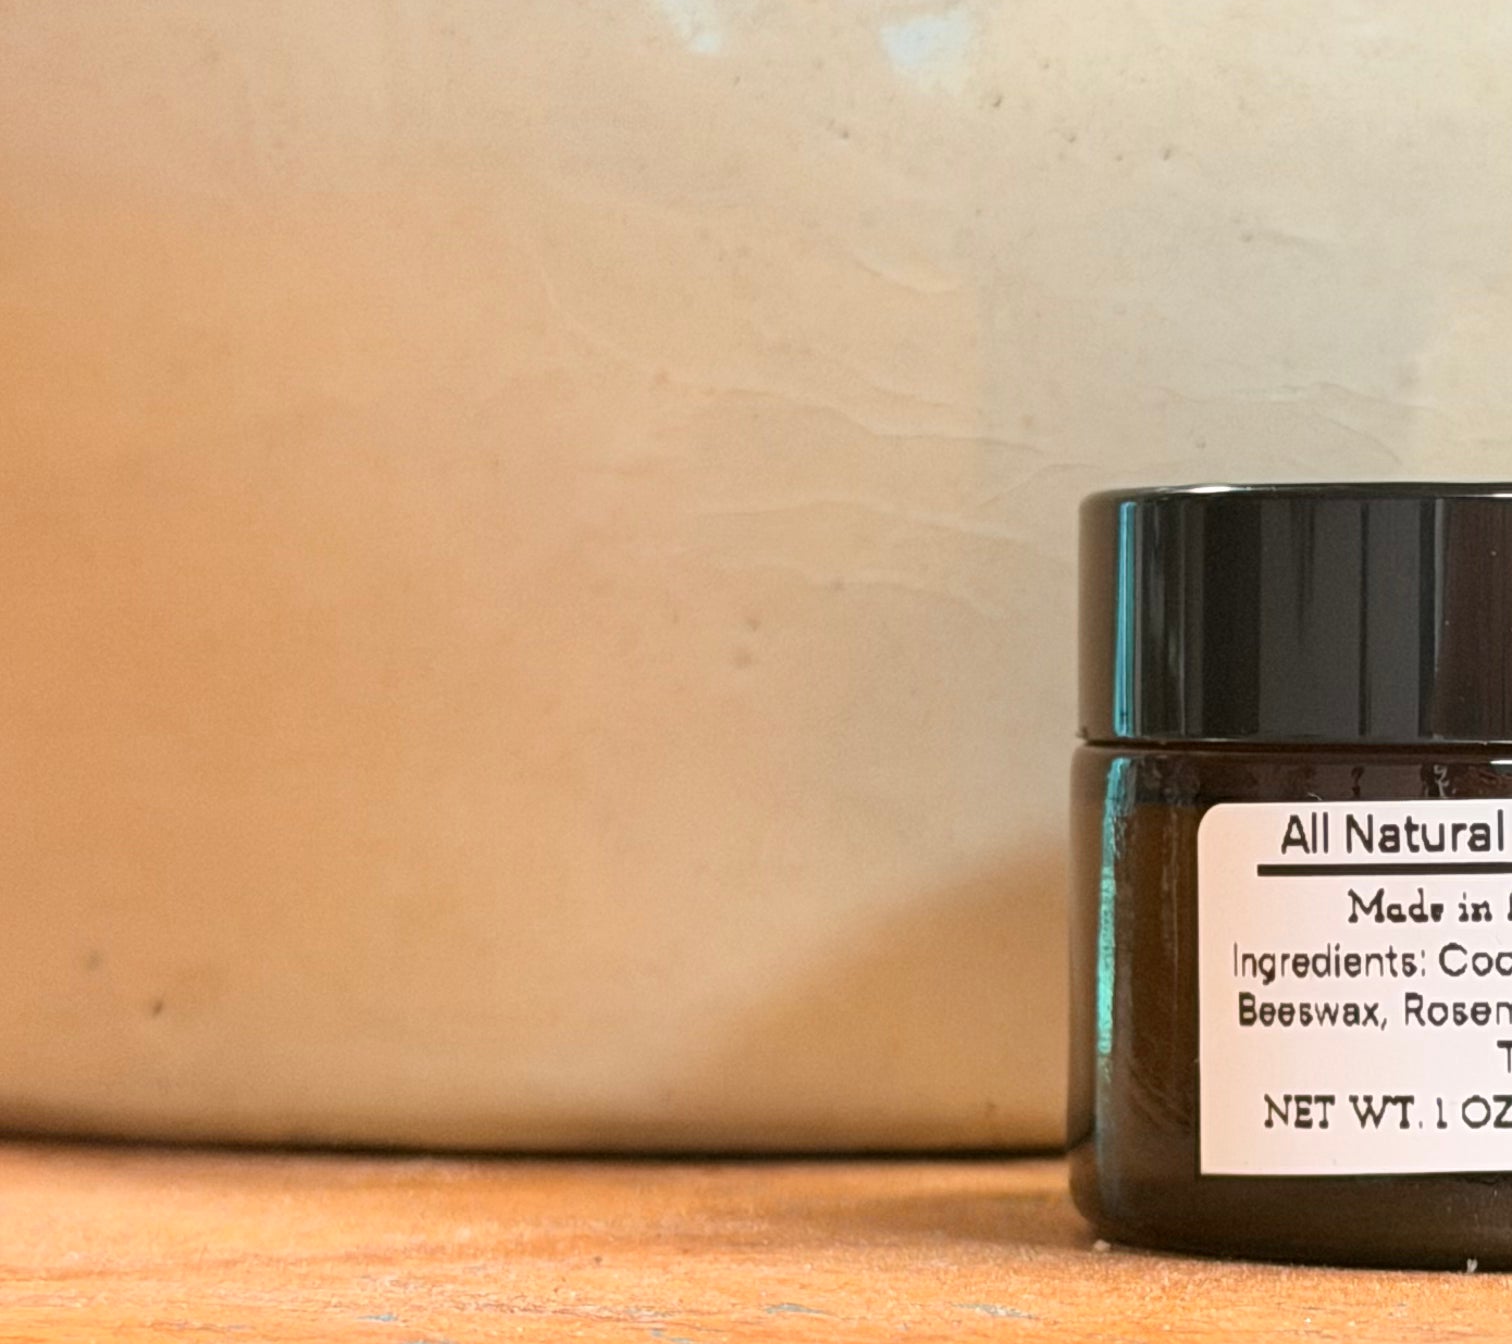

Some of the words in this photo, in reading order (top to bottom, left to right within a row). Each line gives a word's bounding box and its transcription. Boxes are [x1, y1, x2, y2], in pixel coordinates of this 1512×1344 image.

[1281, 812, 1328, 854] All
[1346, 809, 1503, 853] Natural
[1348, 888, 1444, 923] Made
[1459, 893, 1492, 922] in
[1234, 943, 1425, 985] Ingredients:
[1239, 992, 1386, 1030] Beeswax,
[1264, 1094, 1335, 1129] NET
[1349, 1095, 1422, 1129] WT.
